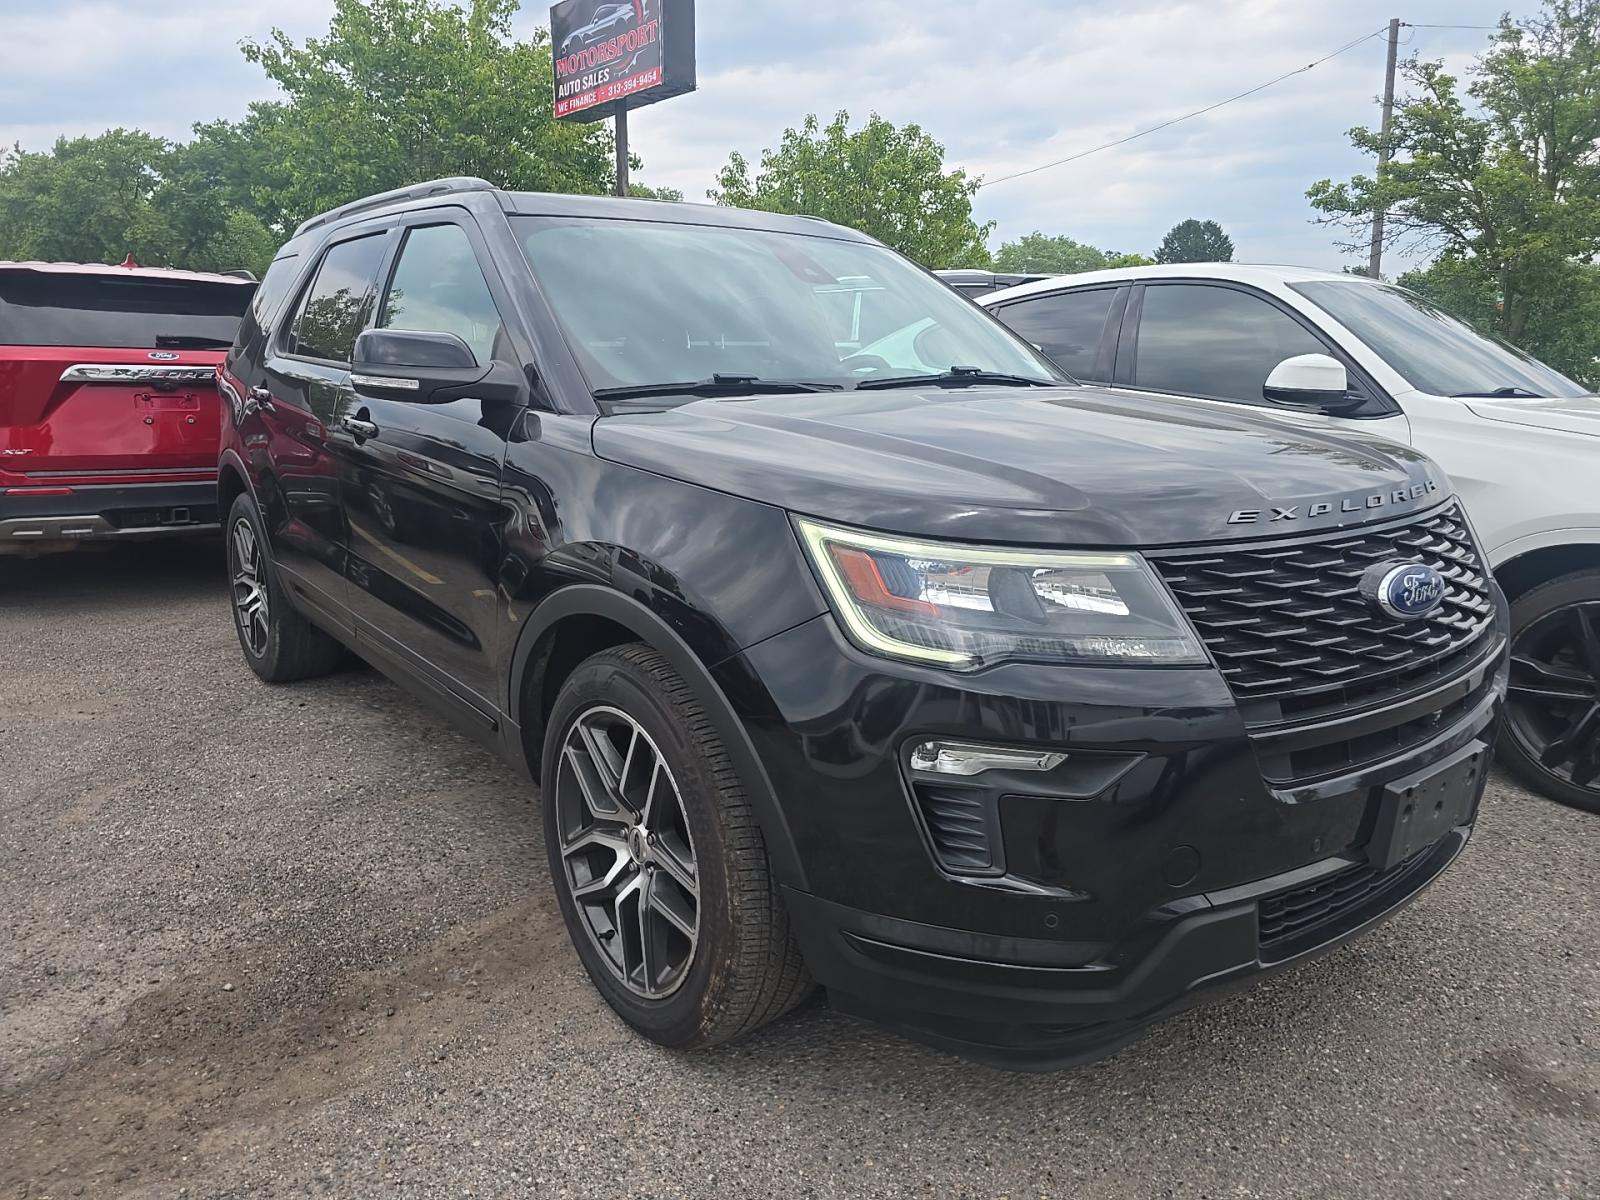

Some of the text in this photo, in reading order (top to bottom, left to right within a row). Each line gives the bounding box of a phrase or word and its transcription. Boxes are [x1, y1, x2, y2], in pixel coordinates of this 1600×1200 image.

[556, 20, 658, 79] MOTORSPORT
[558, 68, 610, 99] AUTO SALES
[558, 101, 569, 113] WE
[569, 92, 597, 109] FINANCE
[1226, 480, 1441, 525] EXPLORER
[1403, 573, 1439, 607] Ford
